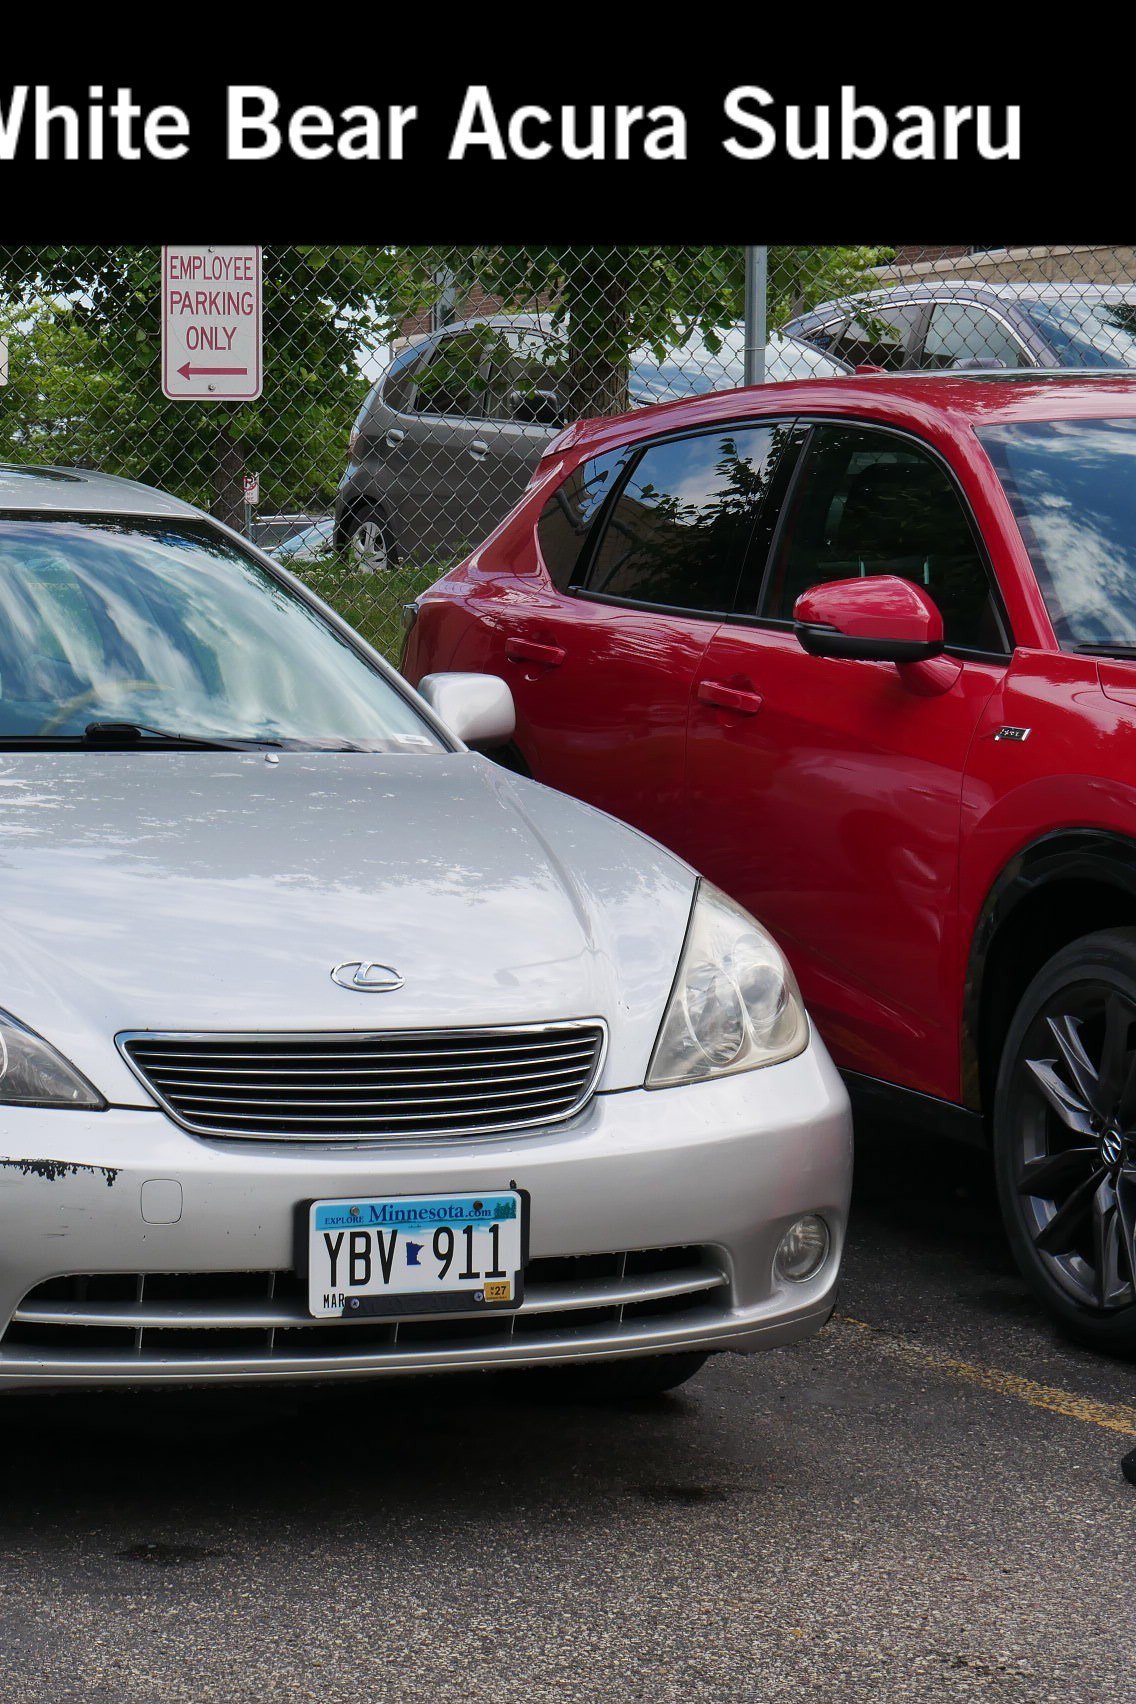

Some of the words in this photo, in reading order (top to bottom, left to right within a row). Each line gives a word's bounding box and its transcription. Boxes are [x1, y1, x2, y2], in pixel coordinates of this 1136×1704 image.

[170, 255, 253, 281] EMPLOYEE
[170, 290, 254, 316] PARKING
[186, 325, 237, 351] ONLY
[324, 1215, 365, 1225] EXPLORE
[323, 1229, 398, 1288] YBV
[432, 1223, 507, 1281] 911
[323, 1293, 346, 1309] MAR
[494, 1285, 507, 1296] 27
